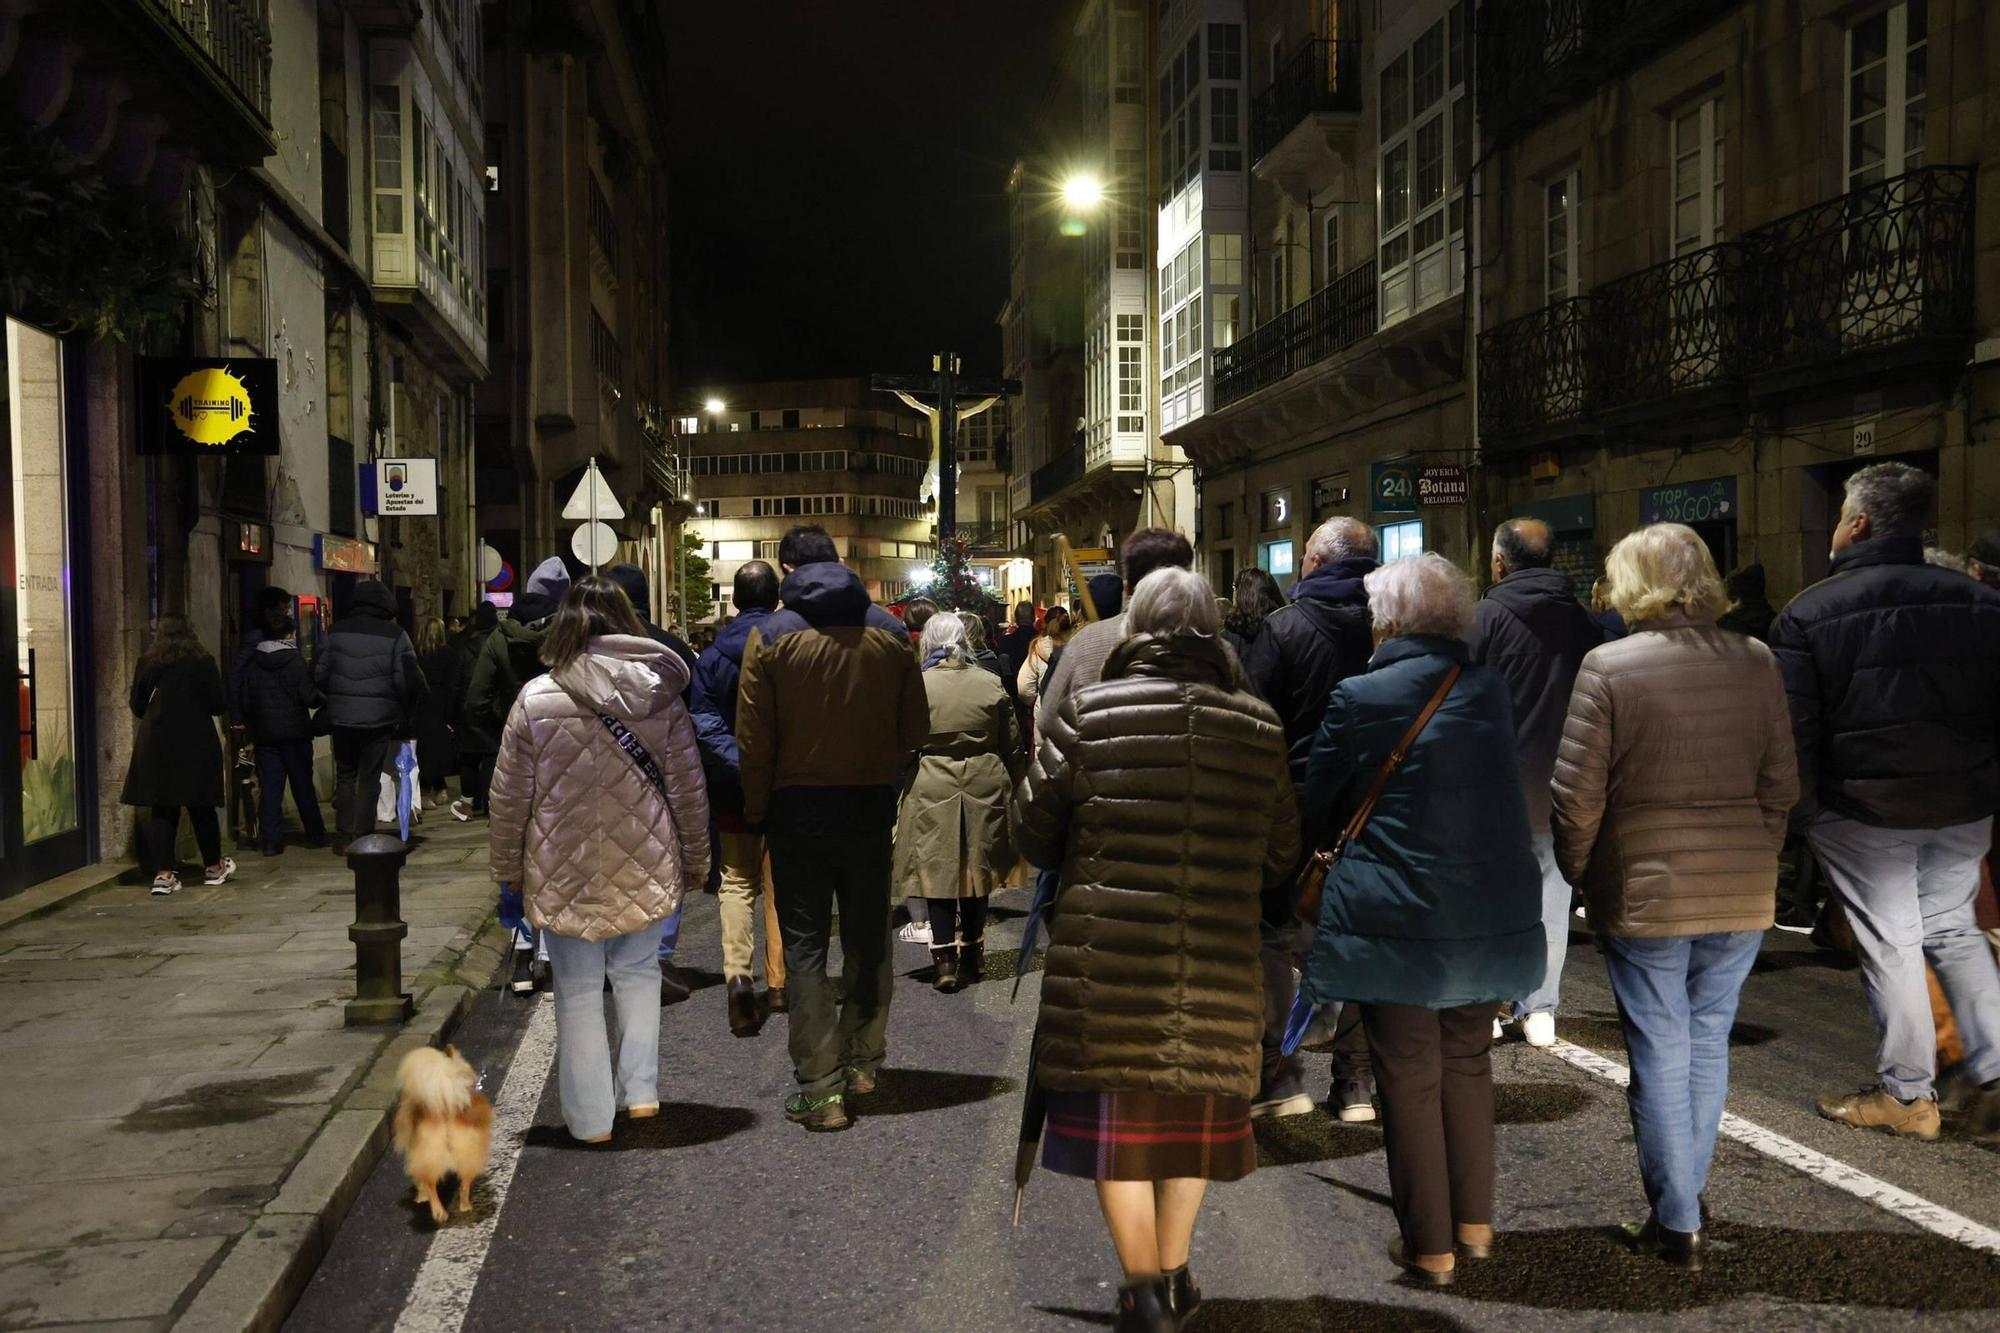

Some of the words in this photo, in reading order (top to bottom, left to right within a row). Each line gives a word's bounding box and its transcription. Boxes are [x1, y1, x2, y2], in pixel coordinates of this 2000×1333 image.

[194, 399, 230, 407] TRAINING
[1855, 431, 1872, 448] 29
[1423, 467, 1460, 477] JOYERIA
[1382, 478, 1408, 497] 24
[1418, 478, 1466, 496] Botana
[1423, 495, 1464, 505] RELOJERIA
[1651, 488, 1683, 506] STOP
[1682, 495, 1712, 523] GO
[20, 574, 59, 592] ENTRADA
